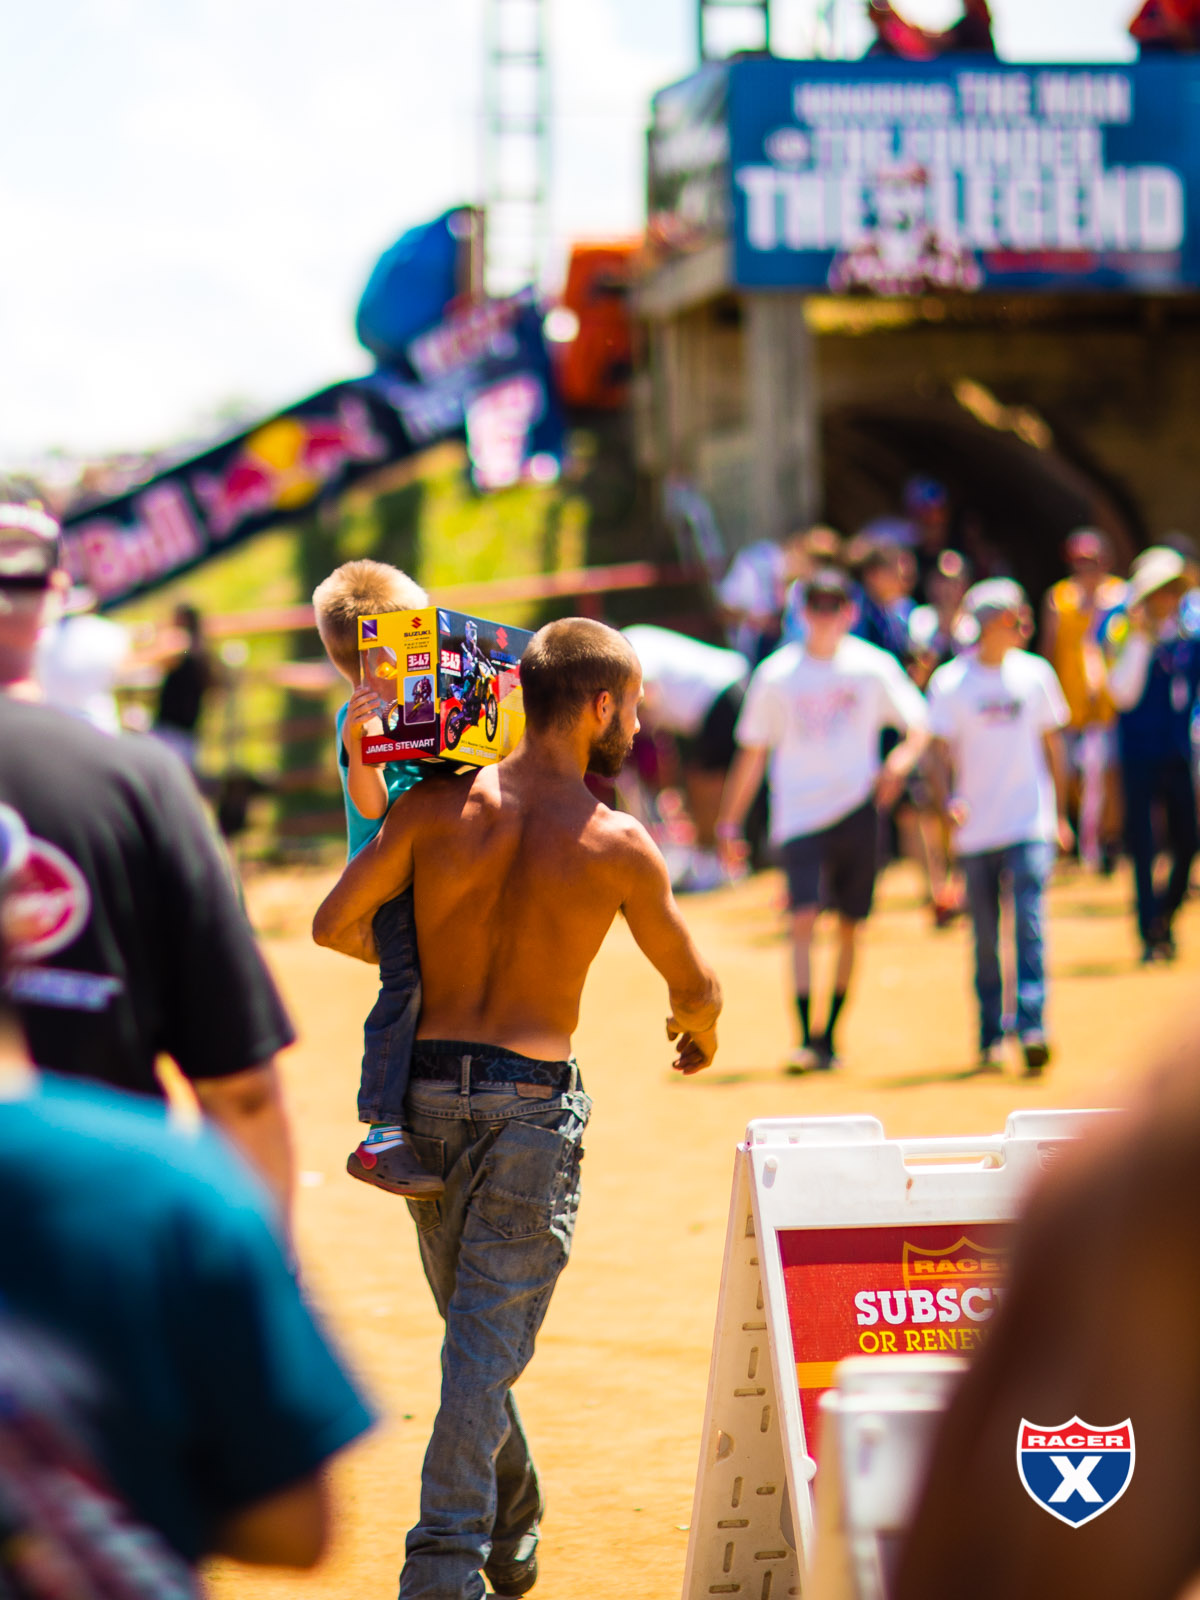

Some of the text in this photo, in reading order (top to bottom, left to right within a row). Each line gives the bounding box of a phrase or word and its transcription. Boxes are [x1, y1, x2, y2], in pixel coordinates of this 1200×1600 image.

[737, 164, 1186, 253] THE LEGEND
[404, 630, 431, 638] SUZUKI
[366, 738, 435, 754] JAMES STEWART
[913, 1258, 1008, 1273] RACE
[854, 1287, 1006, 1326] SUBSC
[859, 1331, 898, 1353] OR
